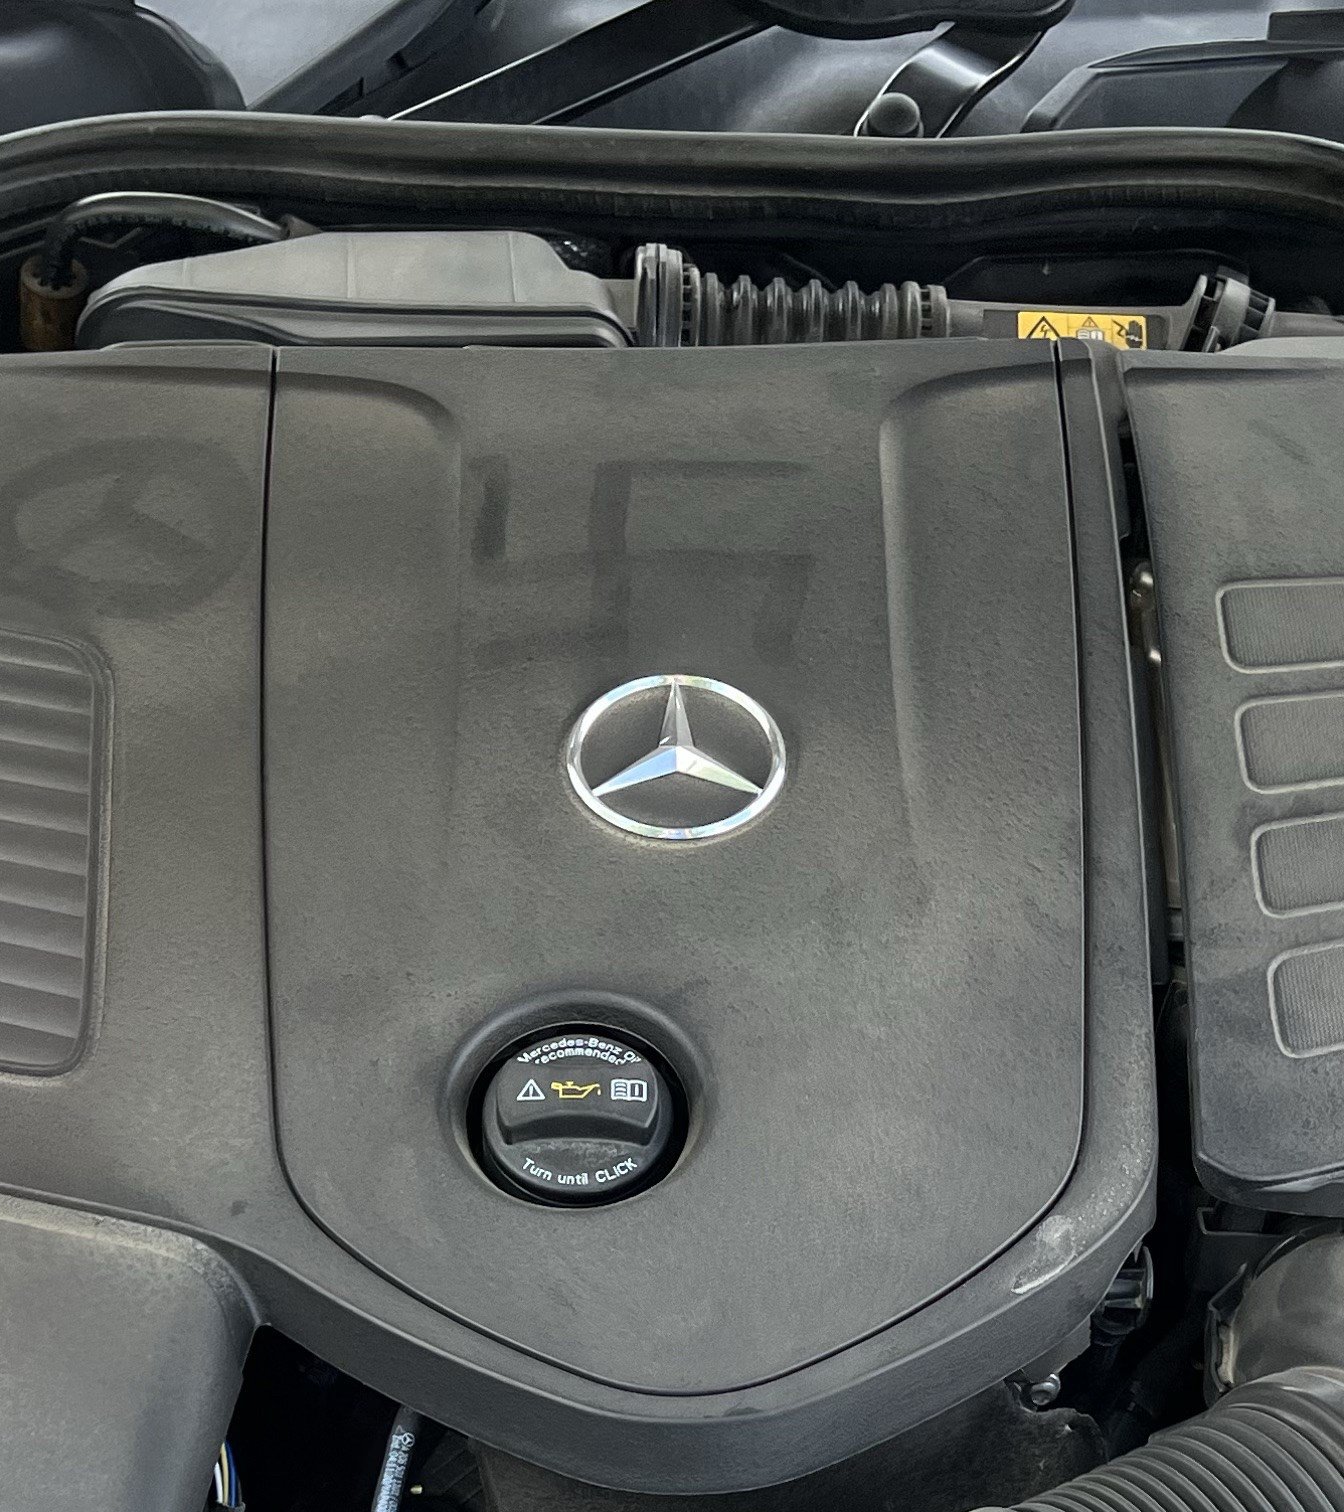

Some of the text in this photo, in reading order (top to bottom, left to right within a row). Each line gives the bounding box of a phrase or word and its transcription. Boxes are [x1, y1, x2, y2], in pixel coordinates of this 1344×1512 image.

[517, 1037, 642, 1063] Mercedes-Benz Oil
[522, 1157, 638, 1186] Turn until CLICK
